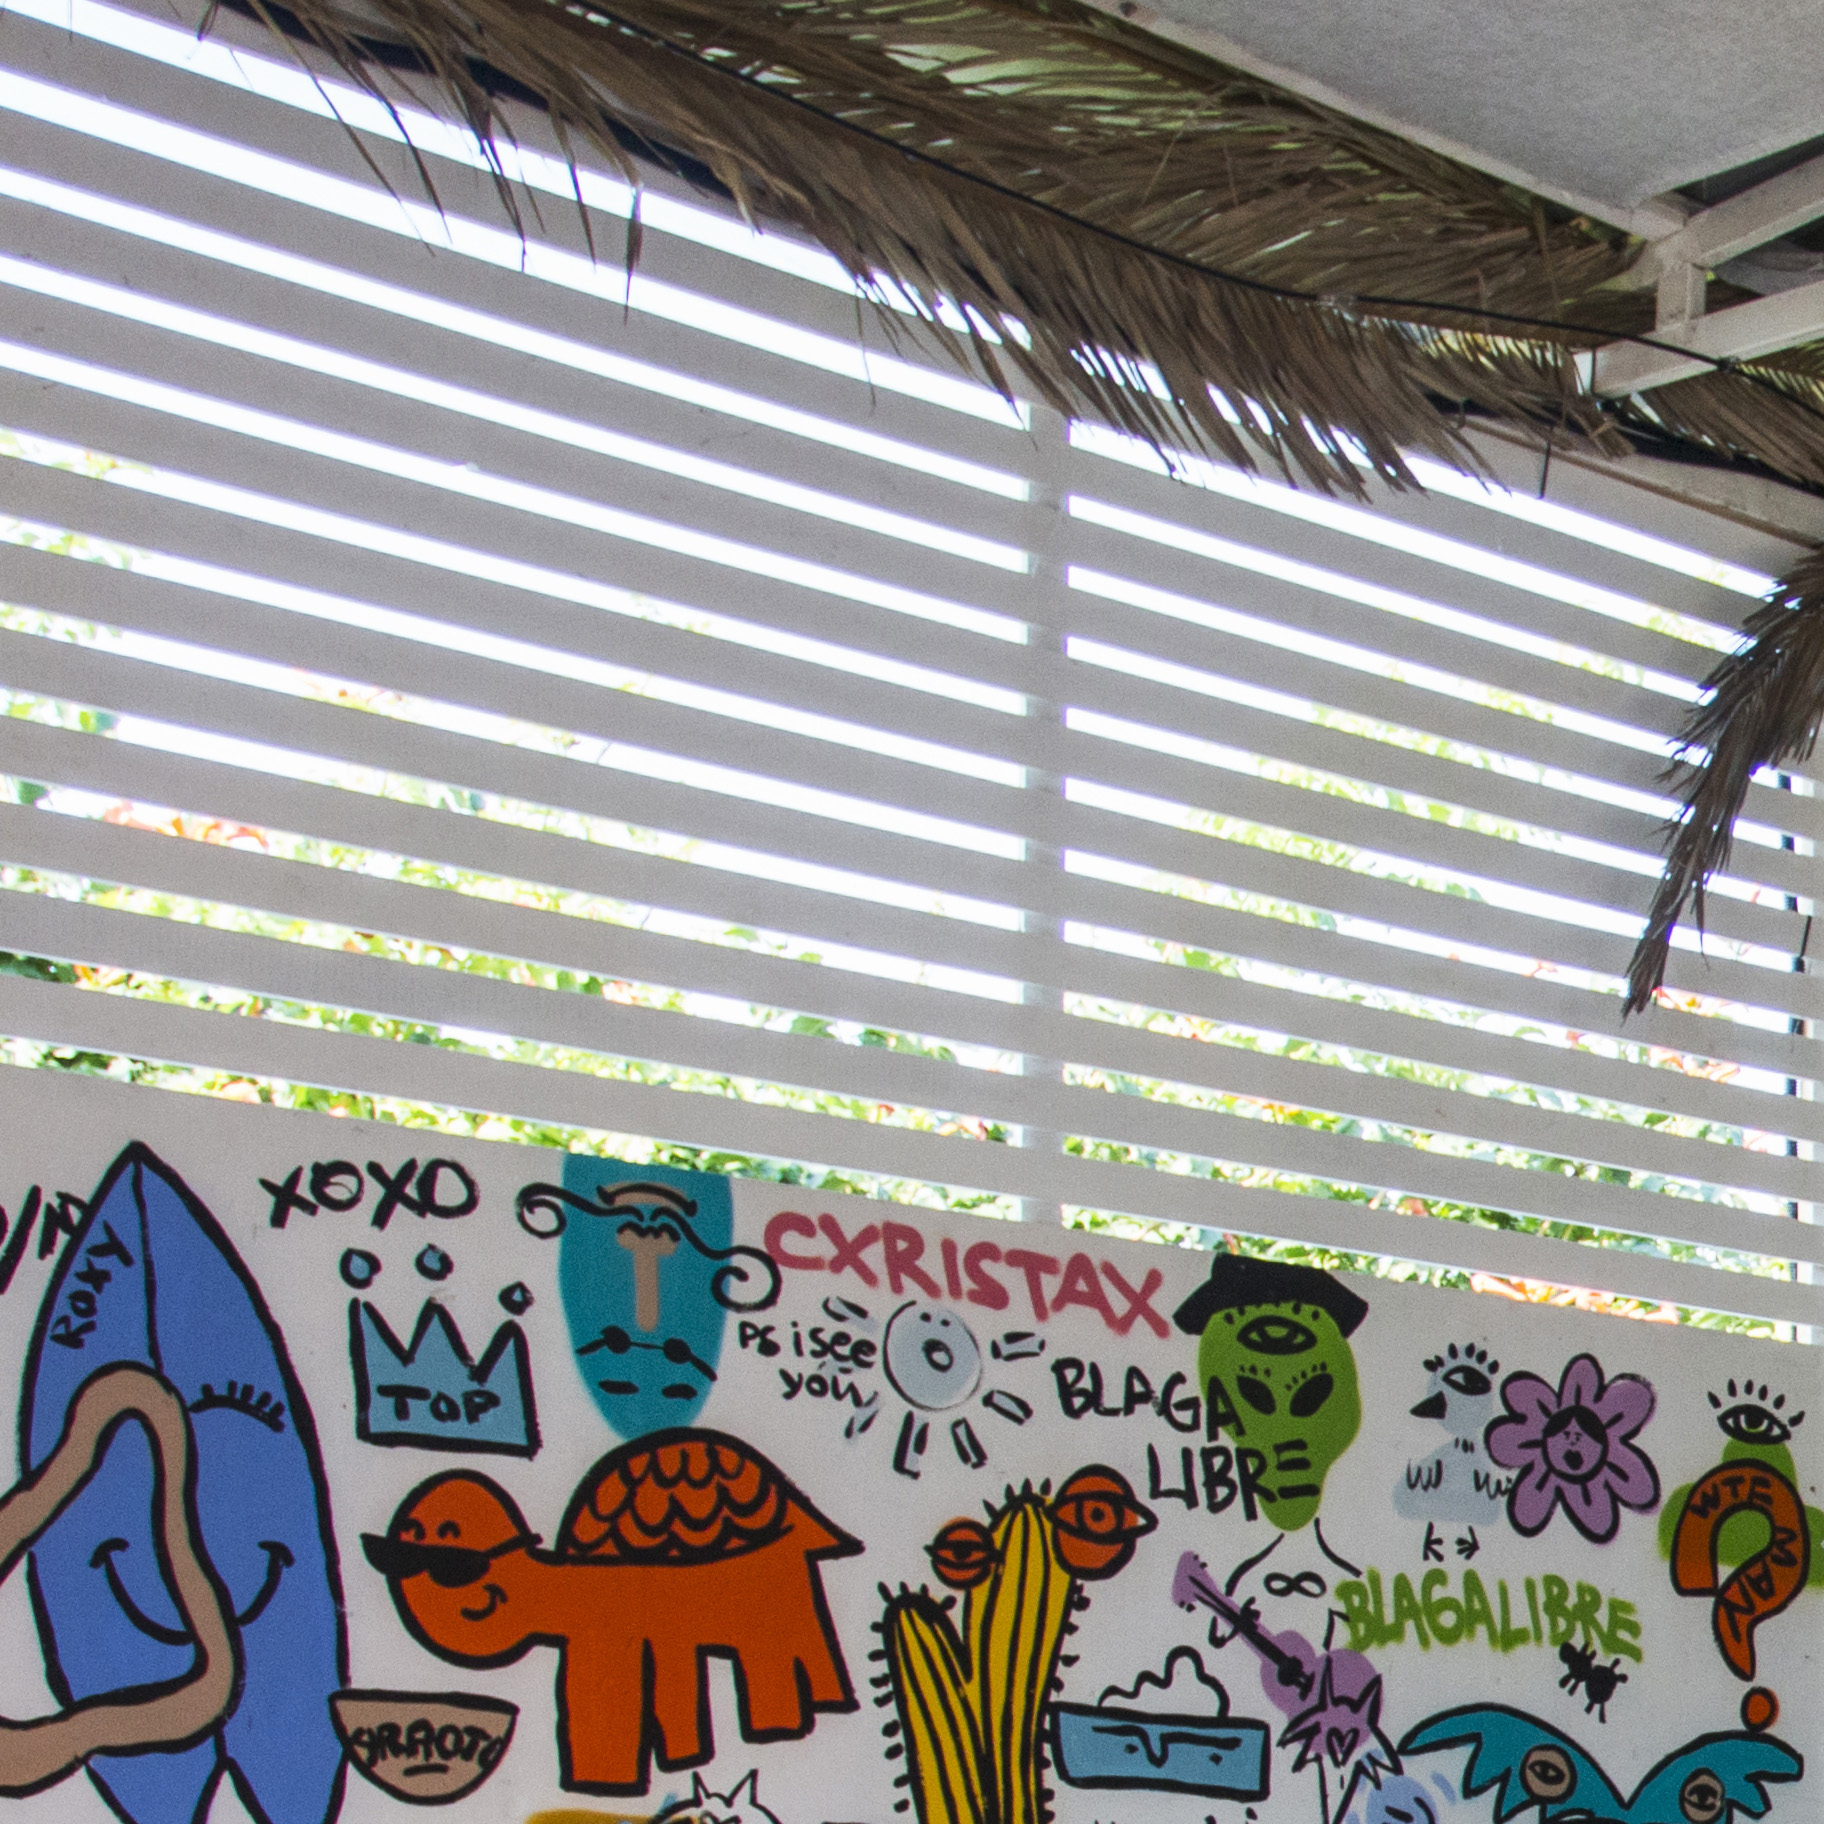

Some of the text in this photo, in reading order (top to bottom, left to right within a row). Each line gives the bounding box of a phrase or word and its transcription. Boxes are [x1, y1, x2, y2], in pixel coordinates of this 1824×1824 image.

[763, 1209, 1171, 1340] CXRISTAX
[376, 1382, 502, 1424] TOP
[1050, 1356, 1247, 1444] BLAGA
[1146, 1439, 1324, 1522] LIBRE
